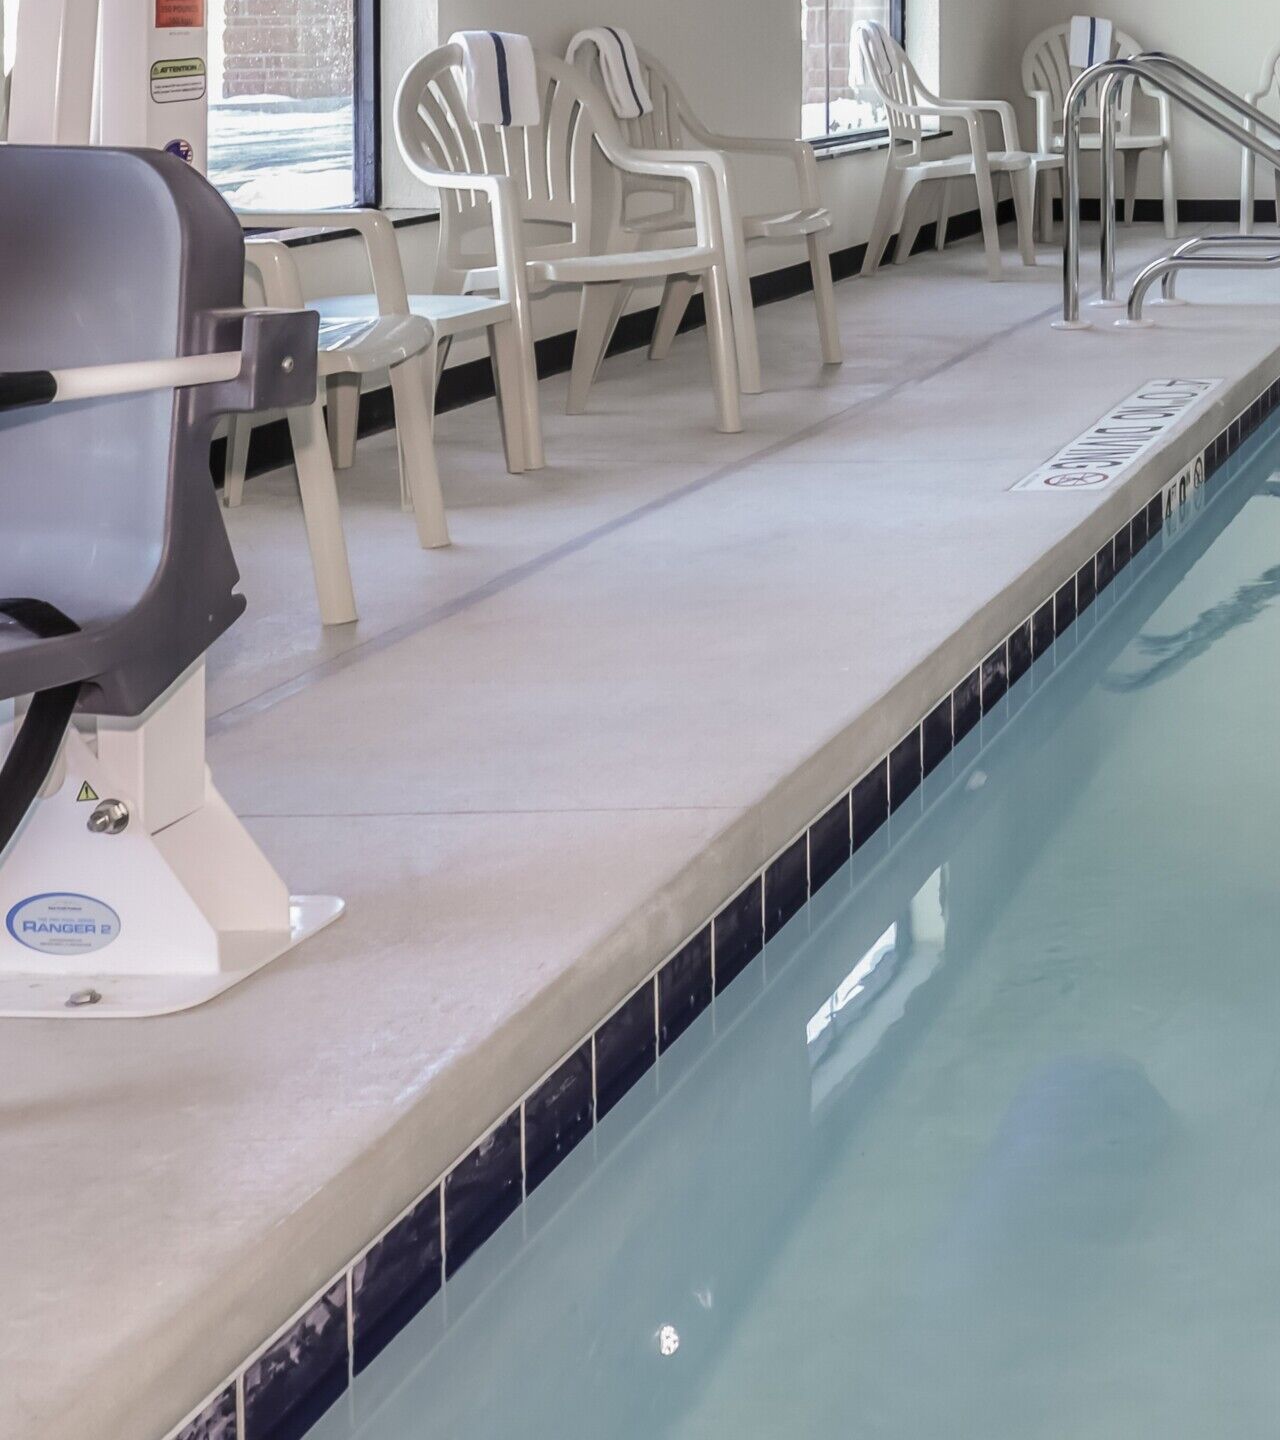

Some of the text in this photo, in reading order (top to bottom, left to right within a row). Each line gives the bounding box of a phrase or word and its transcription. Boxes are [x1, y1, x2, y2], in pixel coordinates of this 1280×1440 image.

[160, 64, 197, 74] ATTENTION
[1050, 426, 1164, 469] DIVING
[23, 920, 97, 934] RANGER
[101, 924, 111, 934] 2
